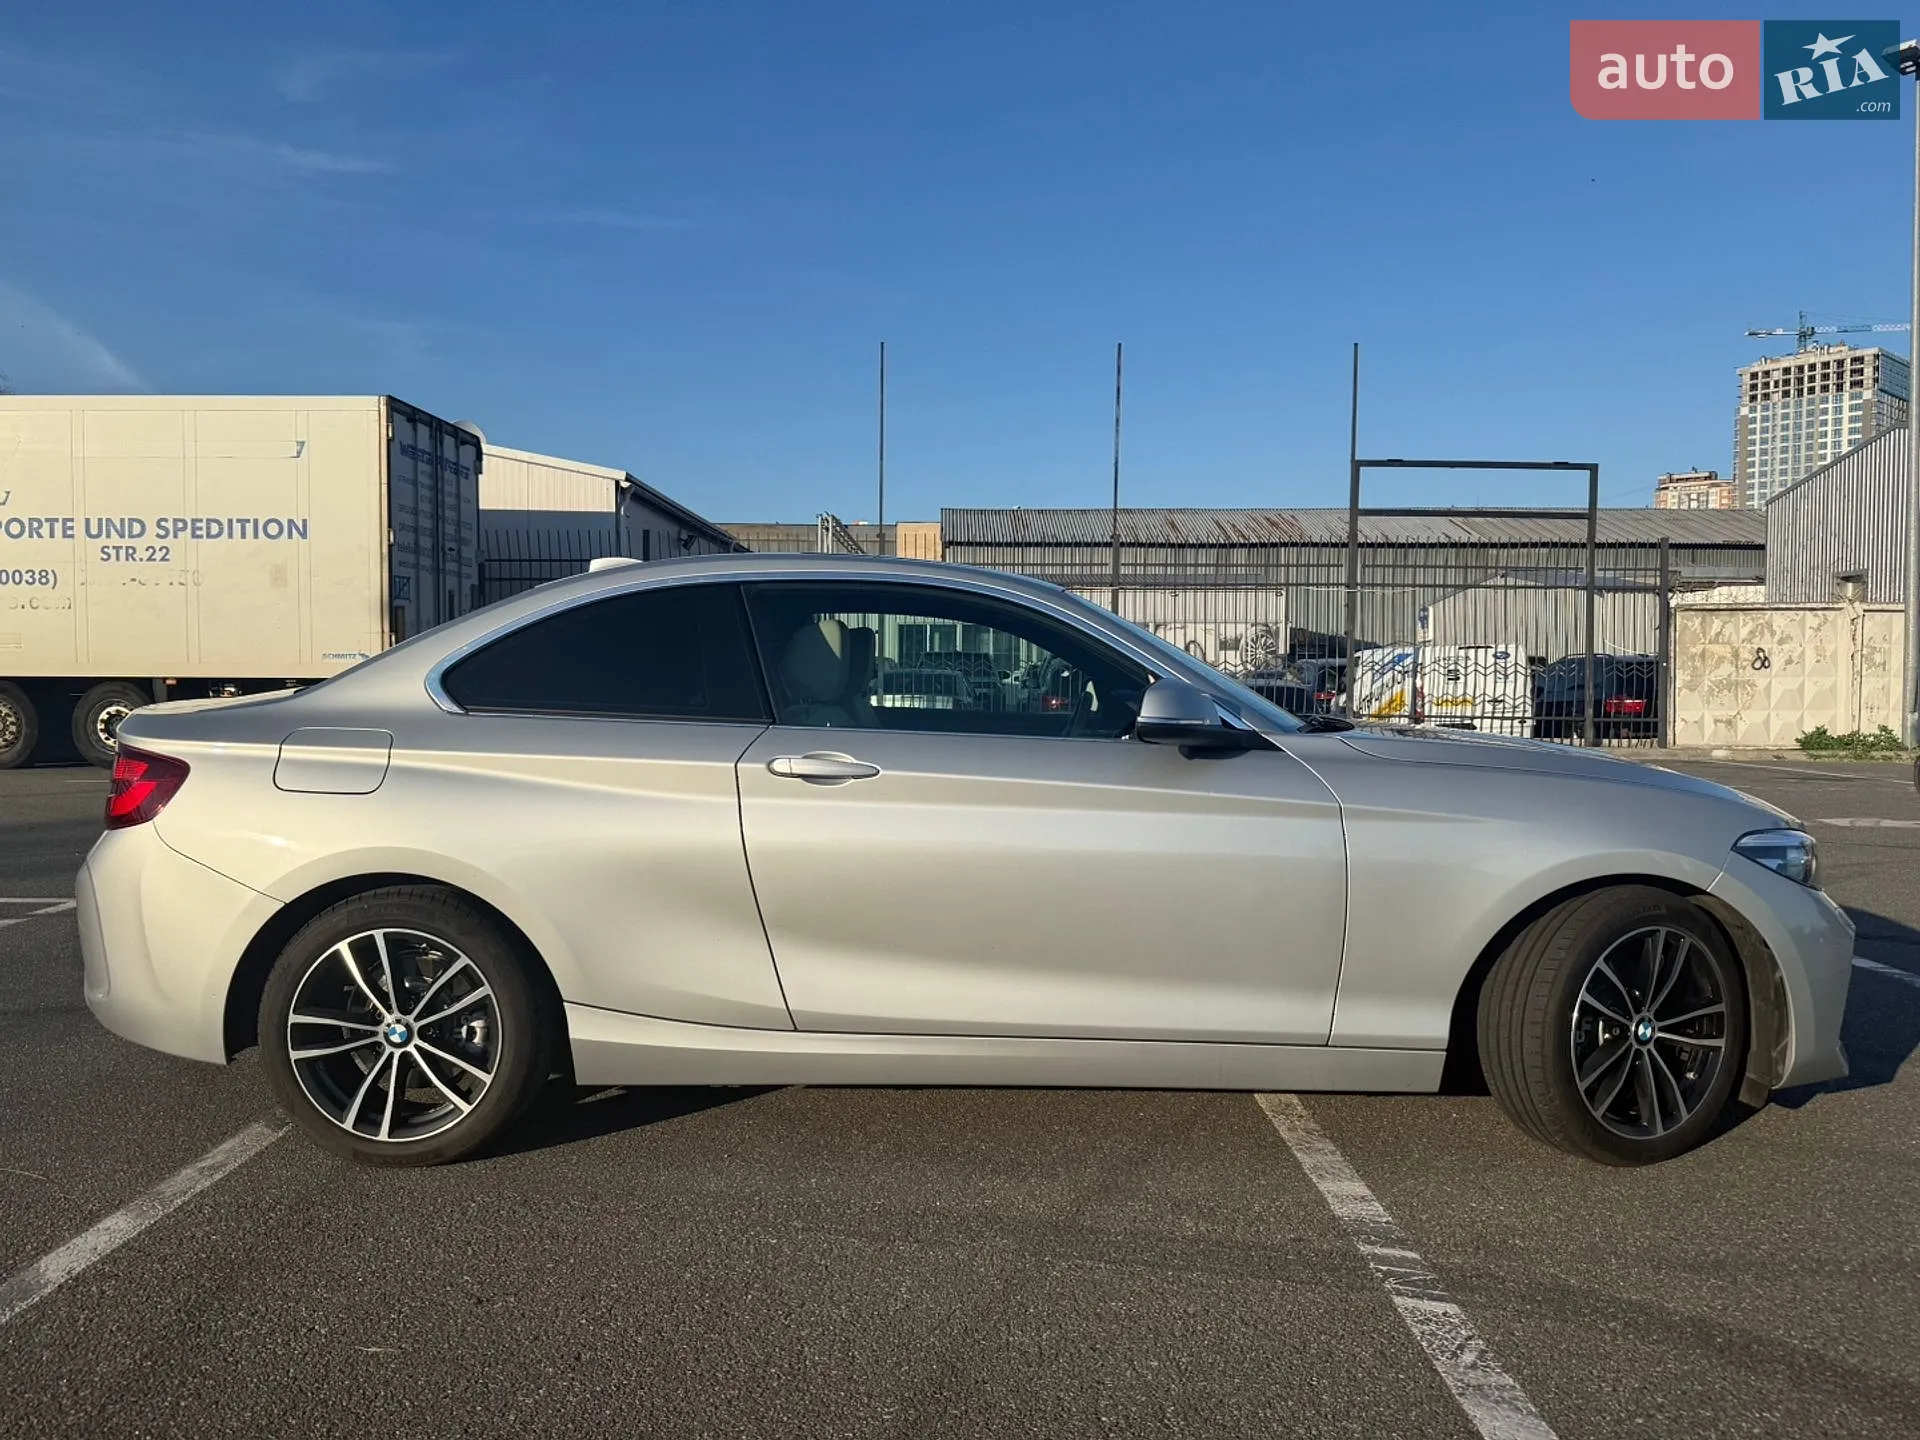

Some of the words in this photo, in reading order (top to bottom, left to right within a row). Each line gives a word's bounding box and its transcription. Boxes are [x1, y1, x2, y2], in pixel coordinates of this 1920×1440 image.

[0, 517, 75, 539] ORTE
[85, 517, 147, 539] UND
[155, 517, 308, 540] SPEDITION
[100, 545, 171, 562] STR.22
